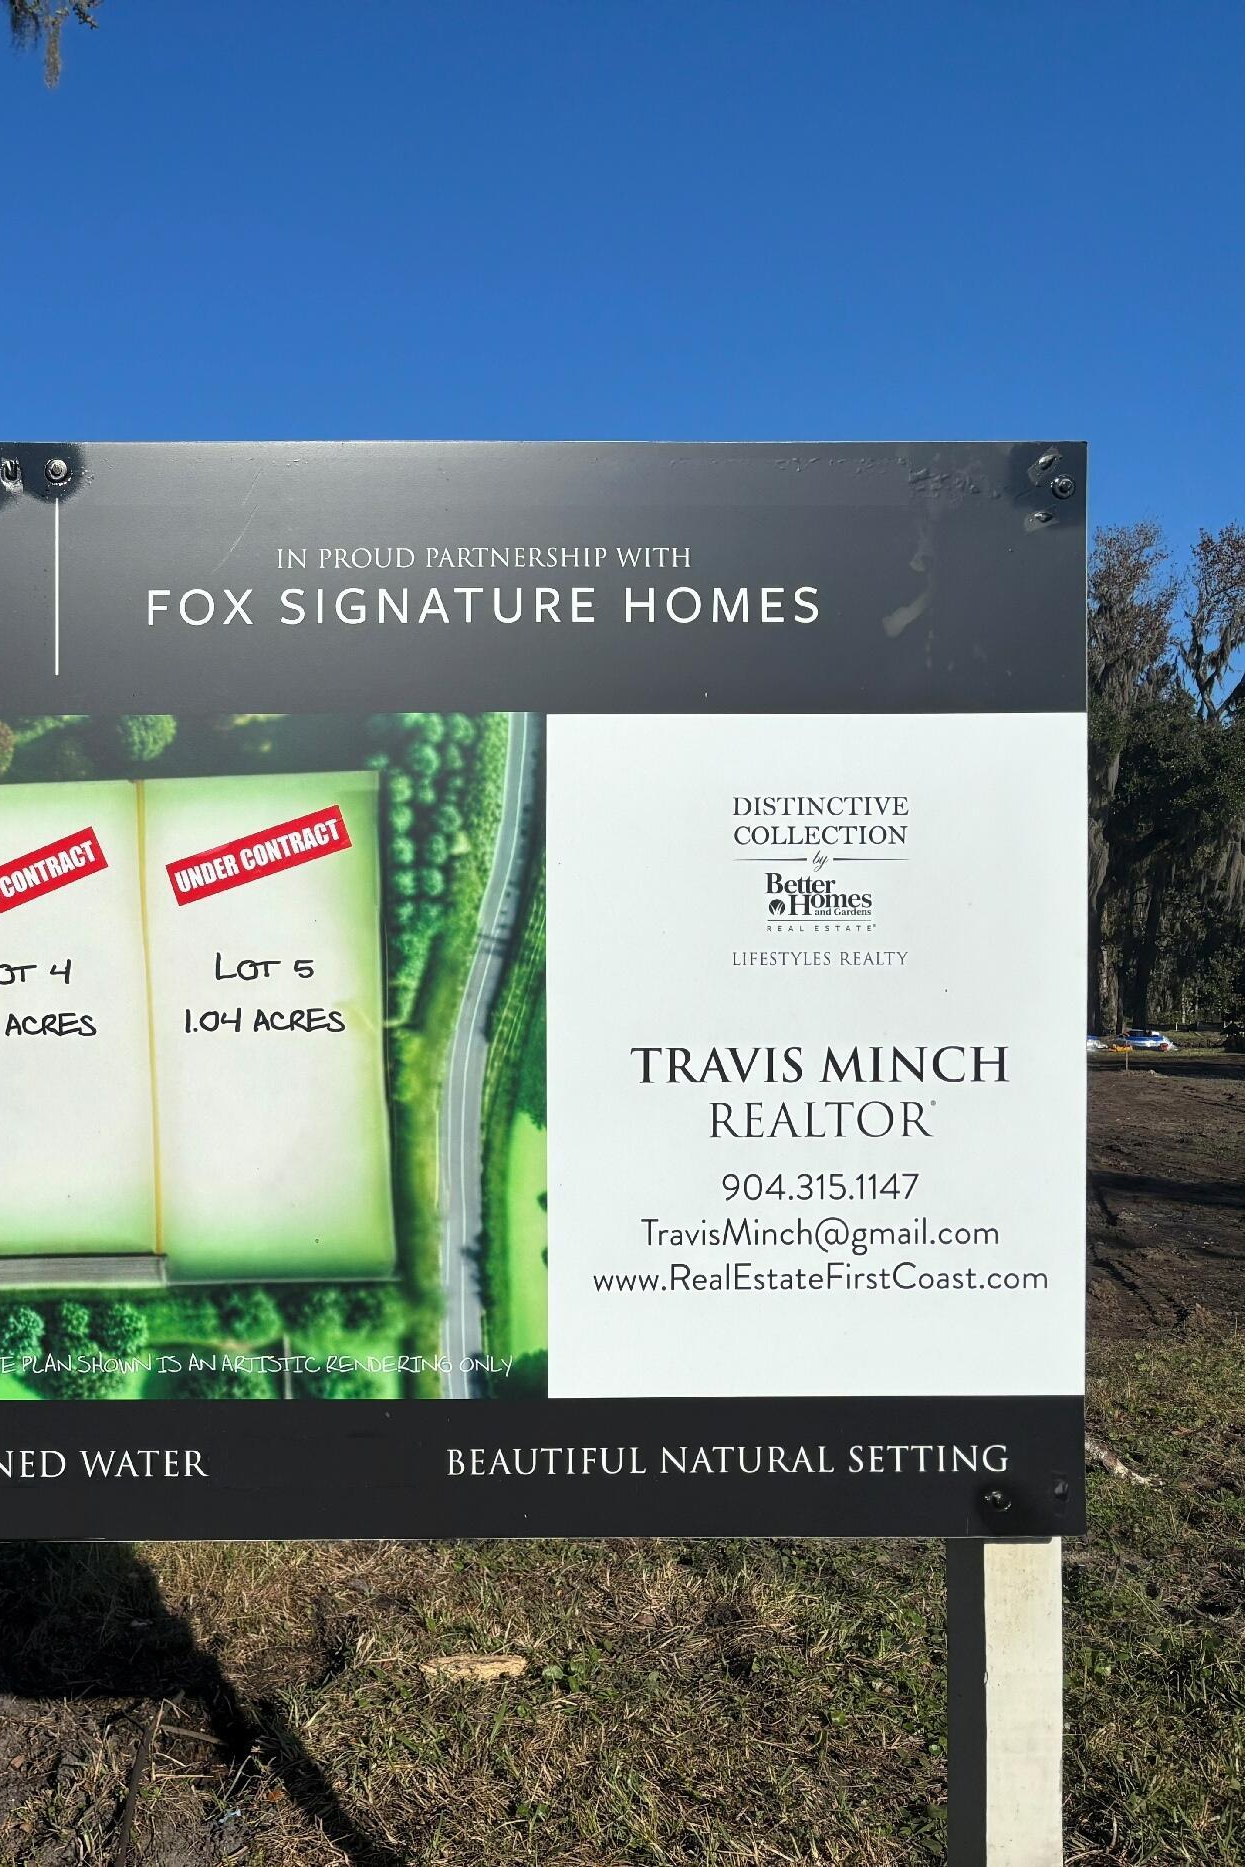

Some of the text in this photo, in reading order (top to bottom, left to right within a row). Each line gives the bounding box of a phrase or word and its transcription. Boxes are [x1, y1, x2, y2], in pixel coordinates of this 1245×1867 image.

[276, 546, 693, 569] IN PROUD PARTNERSHIP WITH
[147, 586, 821, 626] FOX SIGNATURE HOMES
[732, 796, 909, 816] DISTINCTIVE
[733, 825, 908, 845] COLLECTION
[174, 818, 340, 893] UNDER CONTRACT
[812, 850, 829, 872] by
[2, 840, 97, 899] CONTRACT
[764, 872, 836, 894] Better
[788, 893, 872, 916] Homes
[814, 907, 872, 916] and Gardens
[49, 958, 72, 985] 4
[215, 952, 314, 981] LOT 5
[732, 951, 909, 966] LIFESTYLES REALTY
[5, 1012, 98, 1037] ACRES
[185, 1007, 346, 1033] 1.04 ACRES
[630, 1046, 1010, 1084] TRAVIS MINCH
[721, 1172, 920, 1202] 904.315.1147
[641, 1217, 1000, 1256] TravisMinch@gmail.com
[593, 1261, 1049, 1293] www.RealEstateFirstCoast.com
[21, 1355, 73, 1374] PLAN
[76, 1354, 153, 1375] SHOWN
[156, 1355, 183, 1375] IS
[188, 1355, 218, 1374] AN
[221, 1354, 321, 1375] ARTISTIC
[325, 1354, 453, 1374] RENDERING
[459, 1354, 514, 1378] ONLY
[79, 1449, 211, 1478] WATER
[446, 1444, 1009, 1477] BEAUTIFUL NATURAL SETTING
